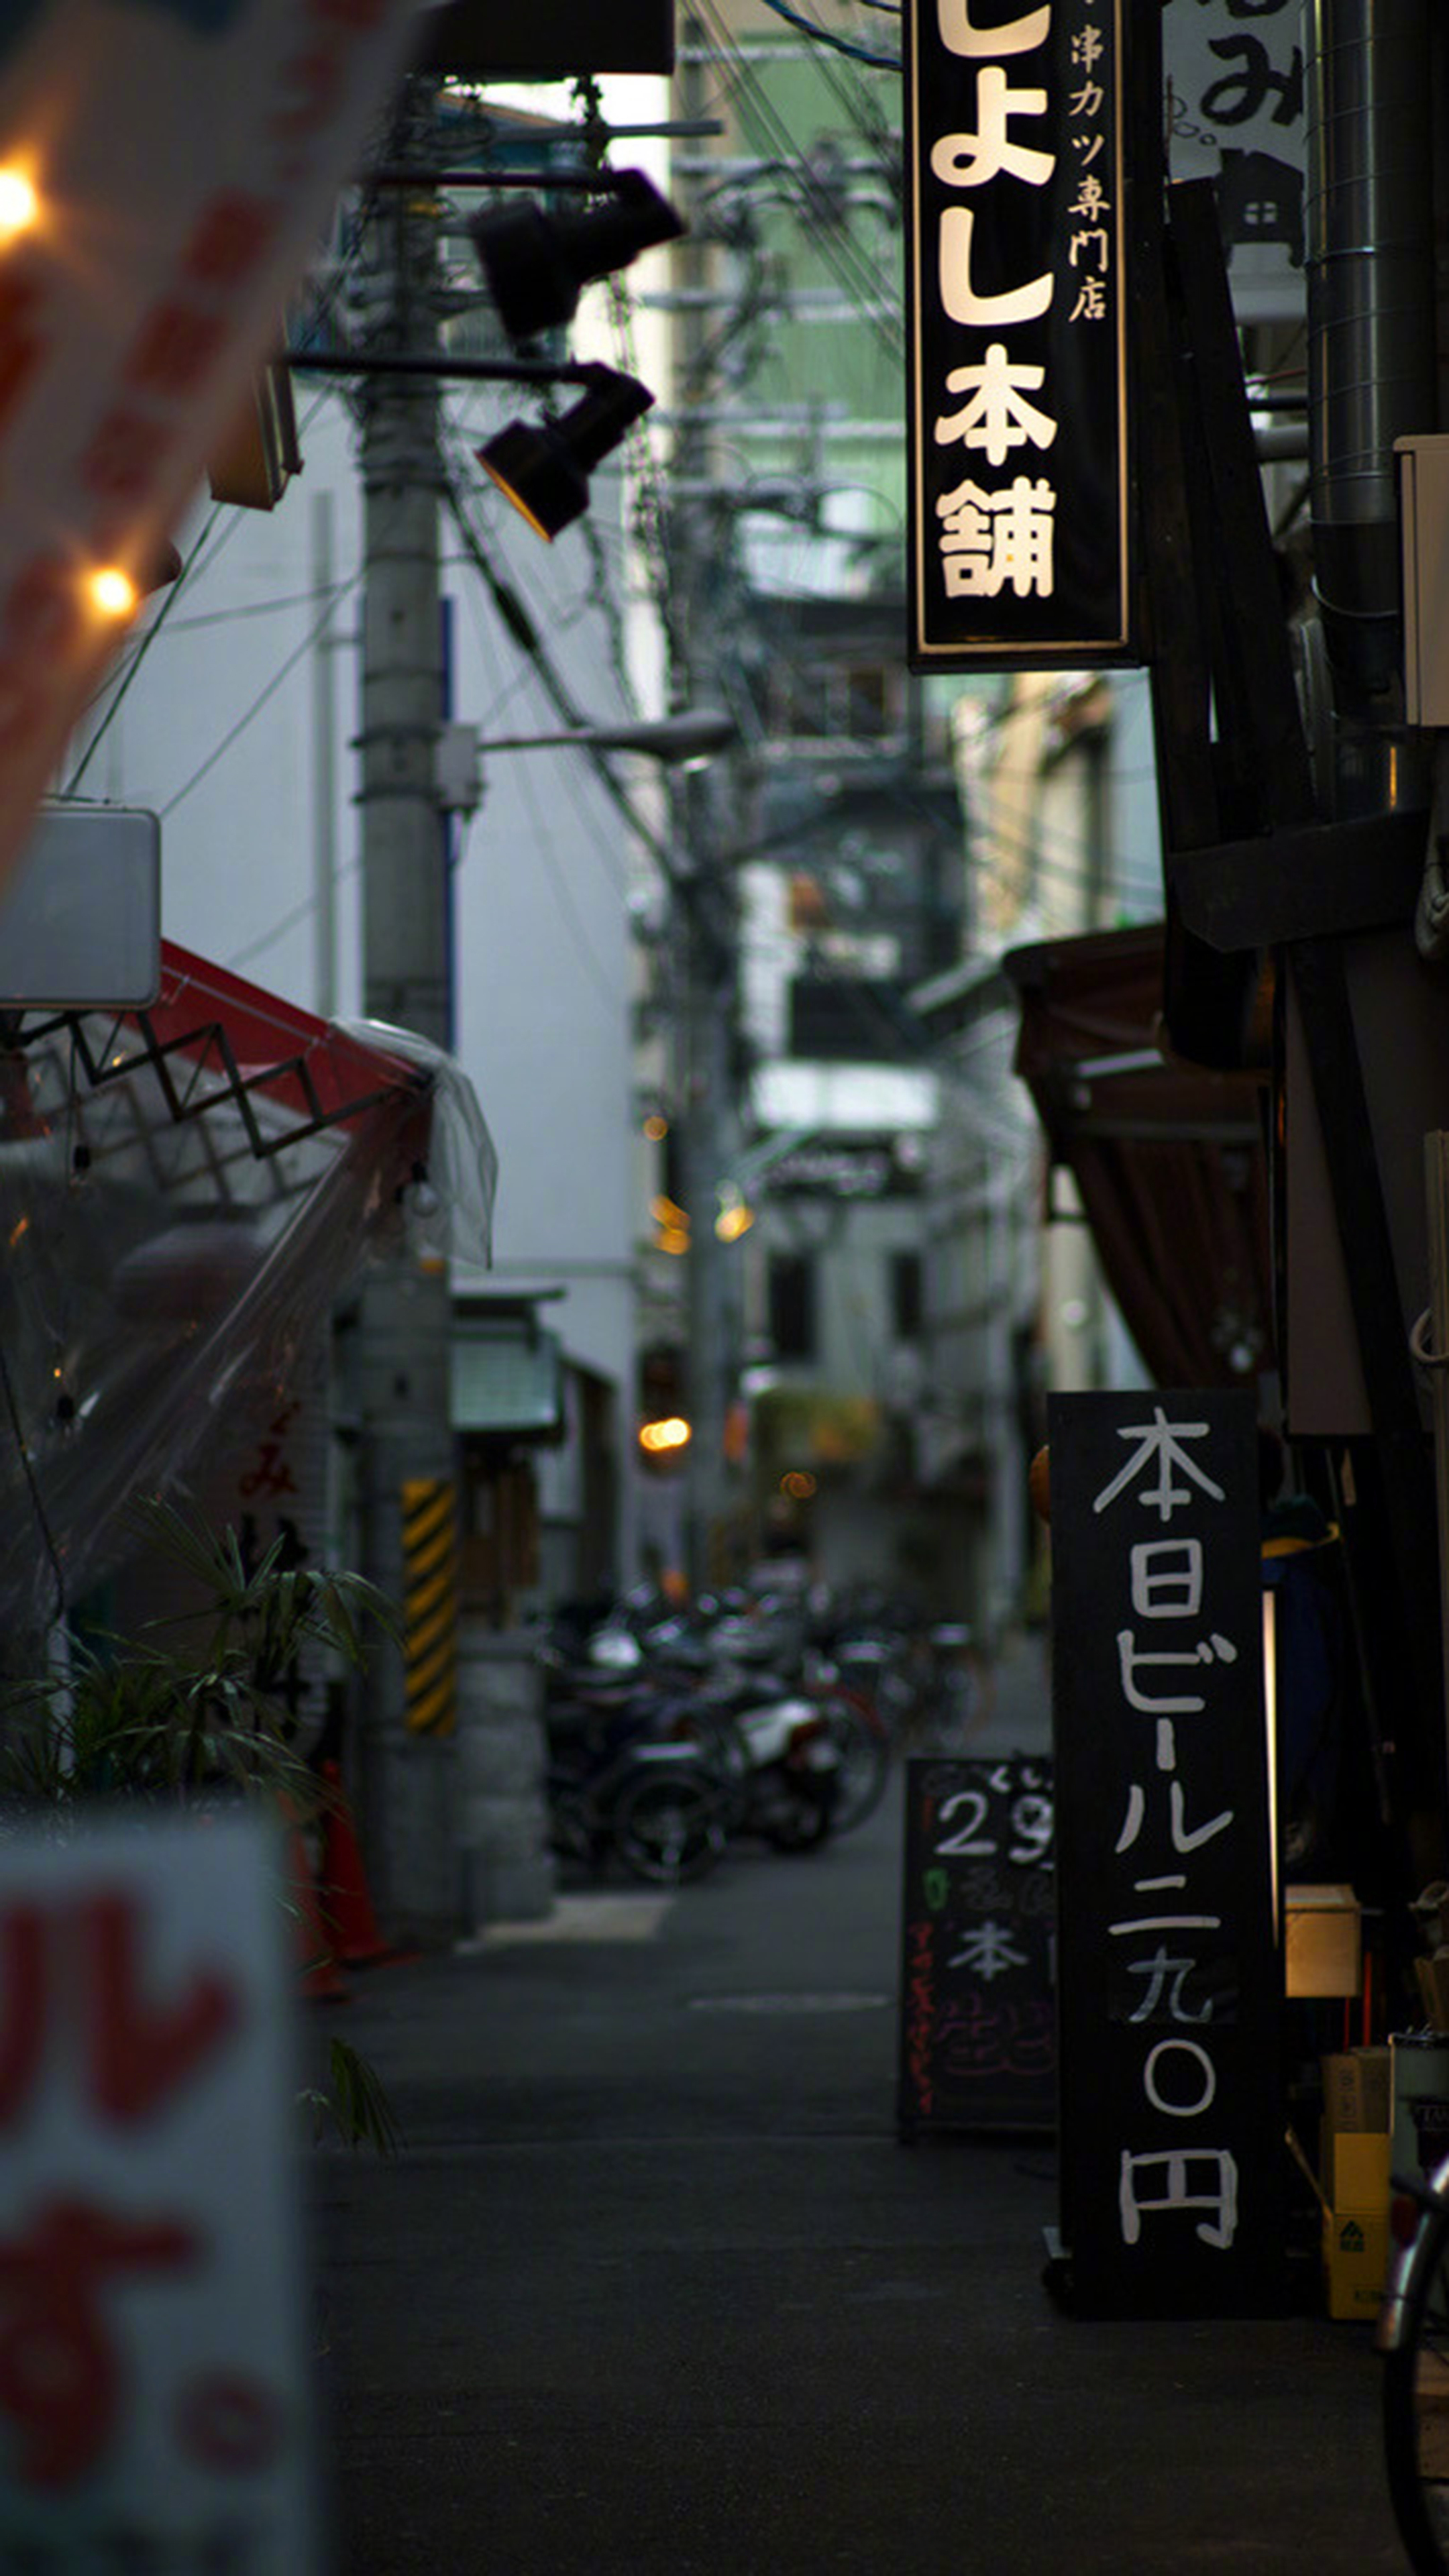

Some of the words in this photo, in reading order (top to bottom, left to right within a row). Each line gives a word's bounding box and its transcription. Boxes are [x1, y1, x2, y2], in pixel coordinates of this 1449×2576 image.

[1068, 24, 1110, 322] 串カツ専門店
